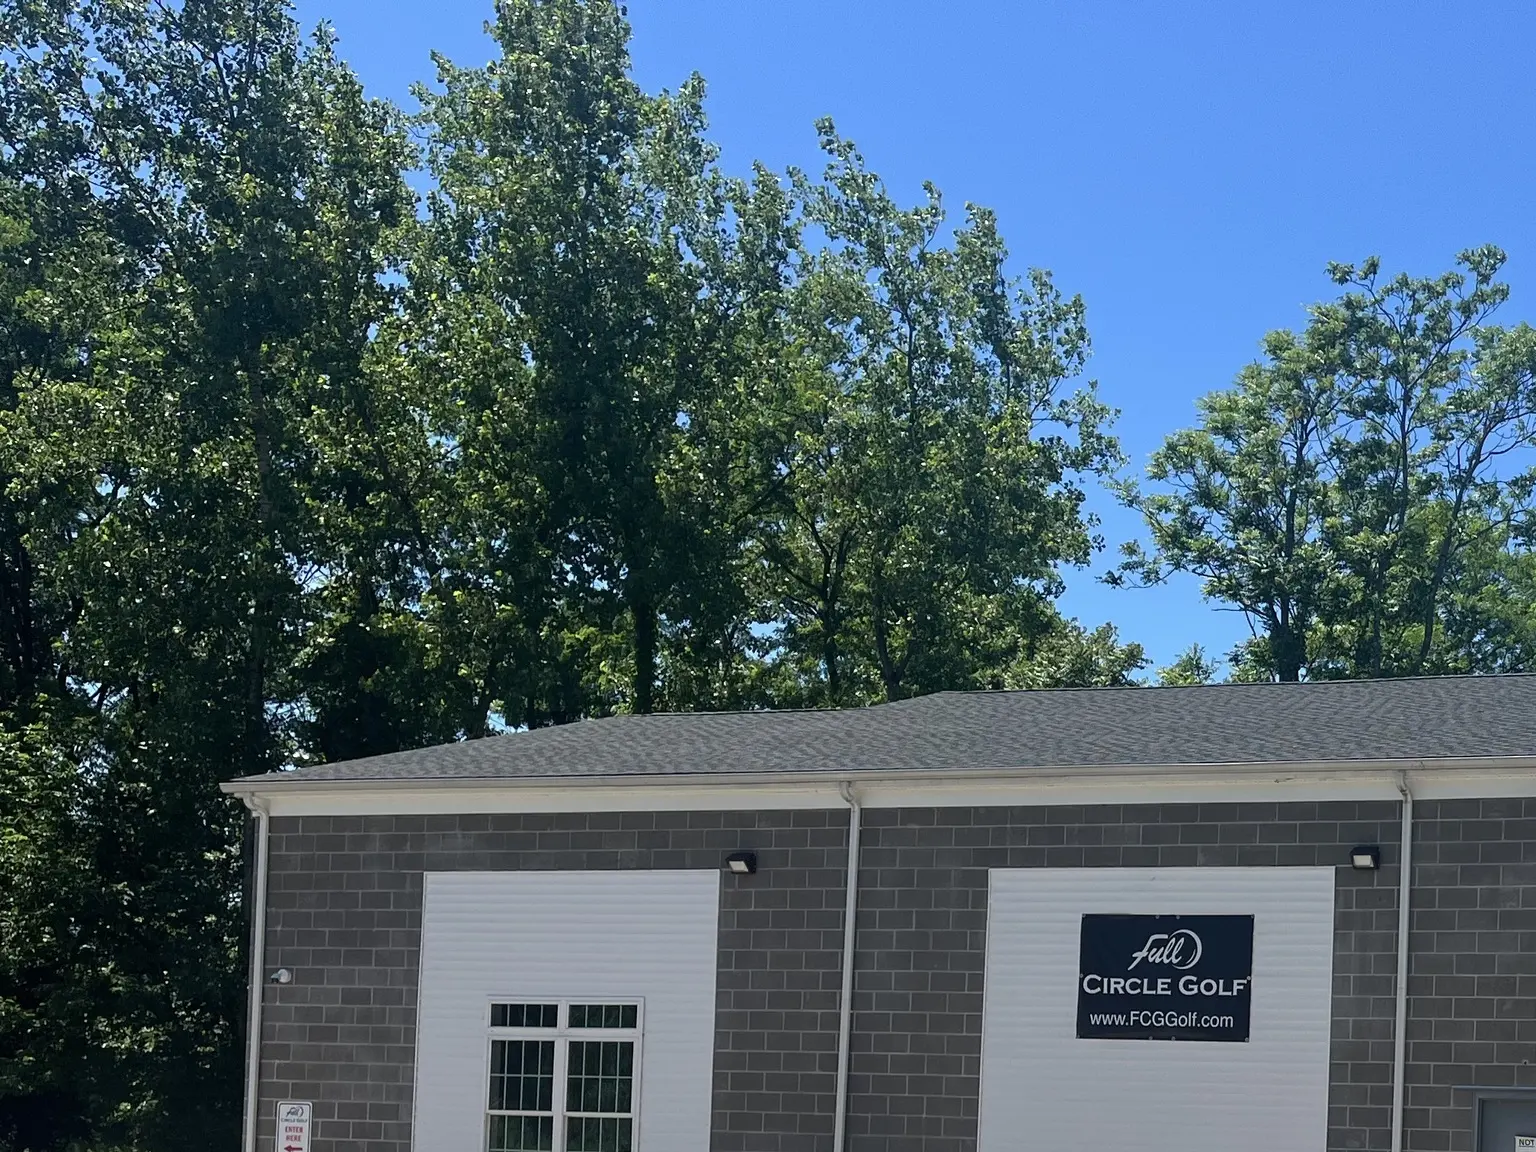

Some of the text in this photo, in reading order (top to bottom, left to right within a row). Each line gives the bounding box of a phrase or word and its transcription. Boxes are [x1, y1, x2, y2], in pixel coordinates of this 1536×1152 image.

[1127, 933, 1186, 971] Full
[1082, 973, 1248, 997] CIRCLE GOLF
[1090, 1010, 1234, 1028] www.FCGGolf.com
[285, 1134, 302, 1142] HERE
[1518, 1138, 1535, 1146] NOT
